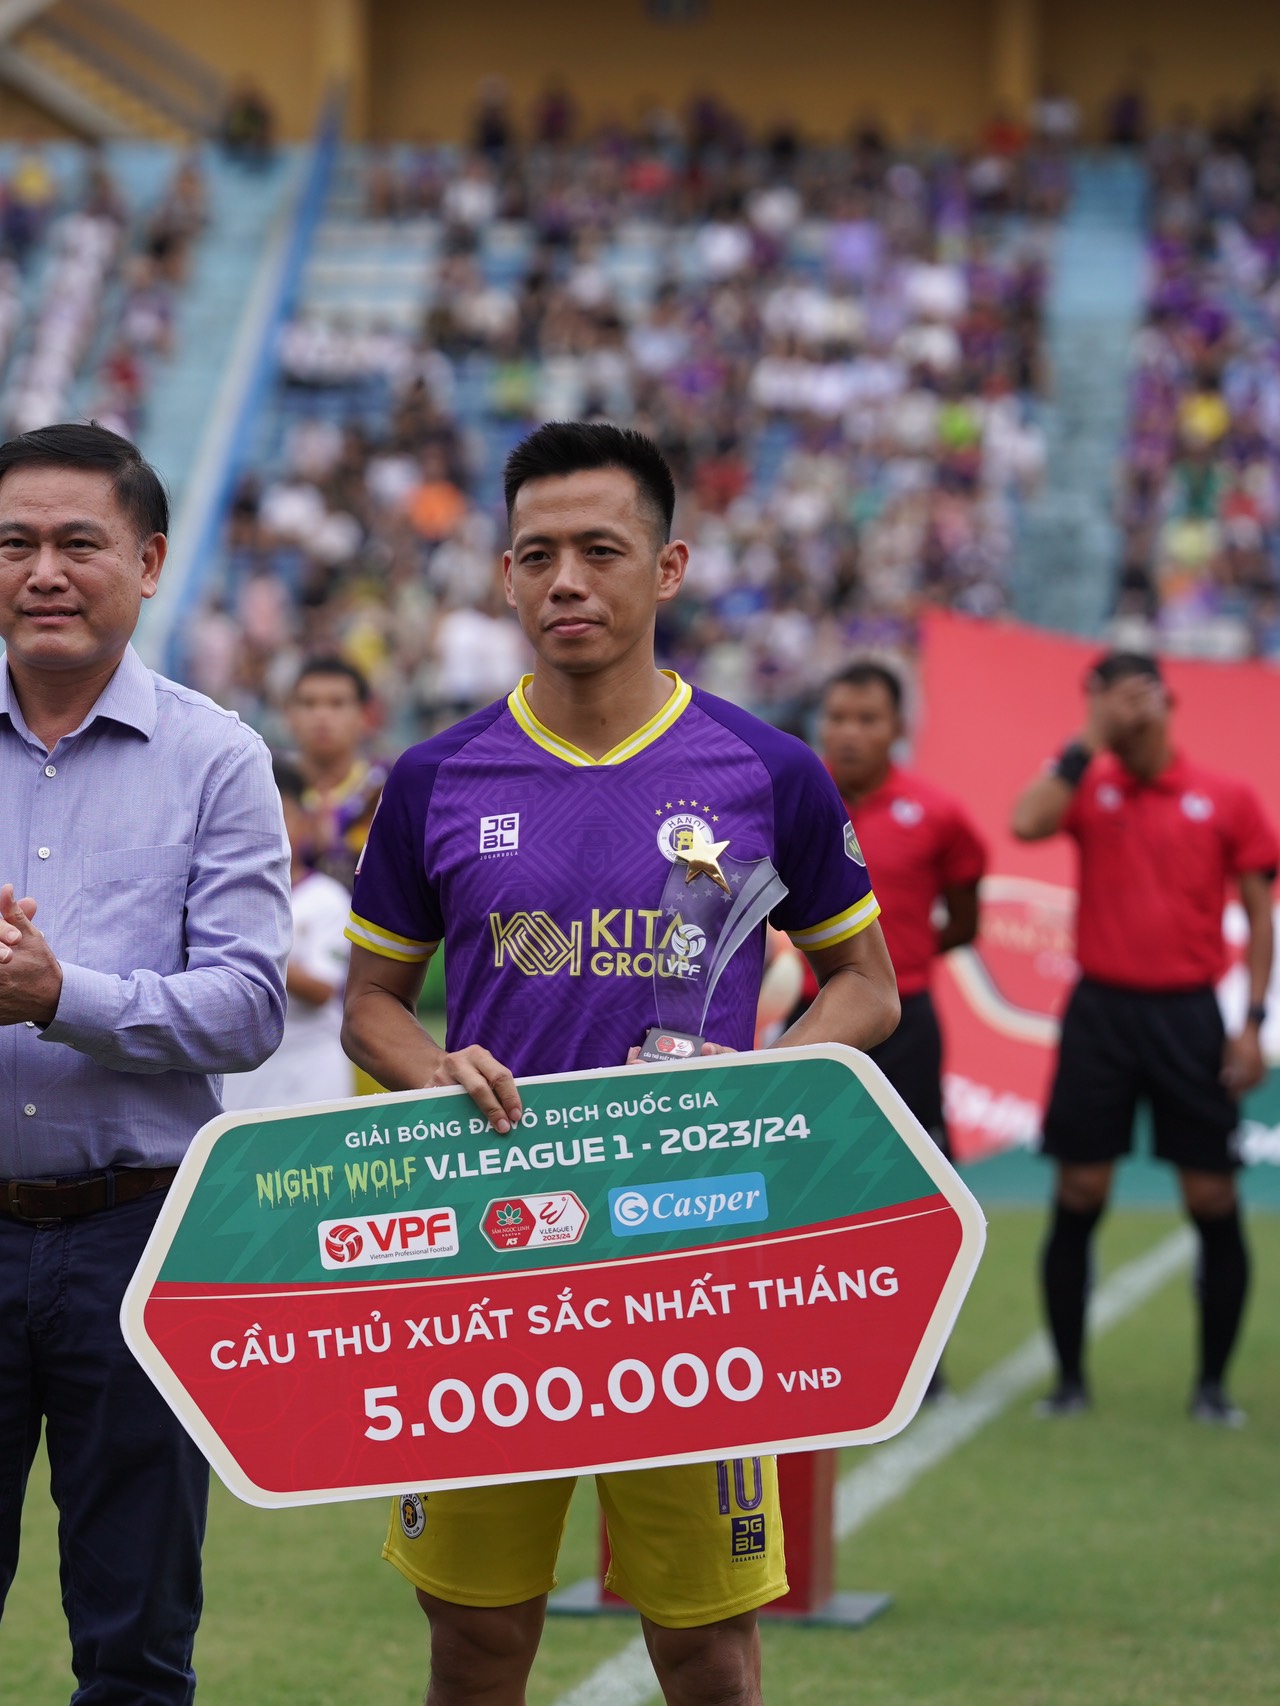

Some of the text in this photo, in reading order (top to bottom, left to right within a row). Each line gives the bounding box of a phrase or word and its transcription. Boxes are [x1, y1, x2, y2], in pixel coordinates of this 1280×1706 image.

[667, 816, 706, 831] HANOI
[590, 908, 690, 950] KITA
[590, 951, 689, 978] GROUP
[666, 958, 701, 976] VPF
[344, 1124, 391, 1148] GIẢI
[398, 1118, 462, 1143] BÓNG
[545, 1104, 600, 1129] ĐỊCH
[606, 1091, 673, 1119] QUỐC
[678, 1091, 719, 1110] GIA
[255, 1163, 334, 1208] NIGHT
[343, 1156, 417, 1204] WOLF
[424, 1136, 606, 1181] V.LEAGUE
[612, 1134, 634, 1161] 1
[659, 1113, 811, 1155] 2023/24
[652, 1188, 760, 1222] Casper
[366, 1212, 451, 1251] VPF
[394, 1248, 429, 1257] Professional
[429, 1245, 454, 1253] Football
[210, 1264, 899, 1370] CẦU THỦ XUẤT SẮC NHẤT THÁNG
[363, 1346, 842, 1441] 5.000.000 VNĐ
[716, 1456, 763, 1515] 10
